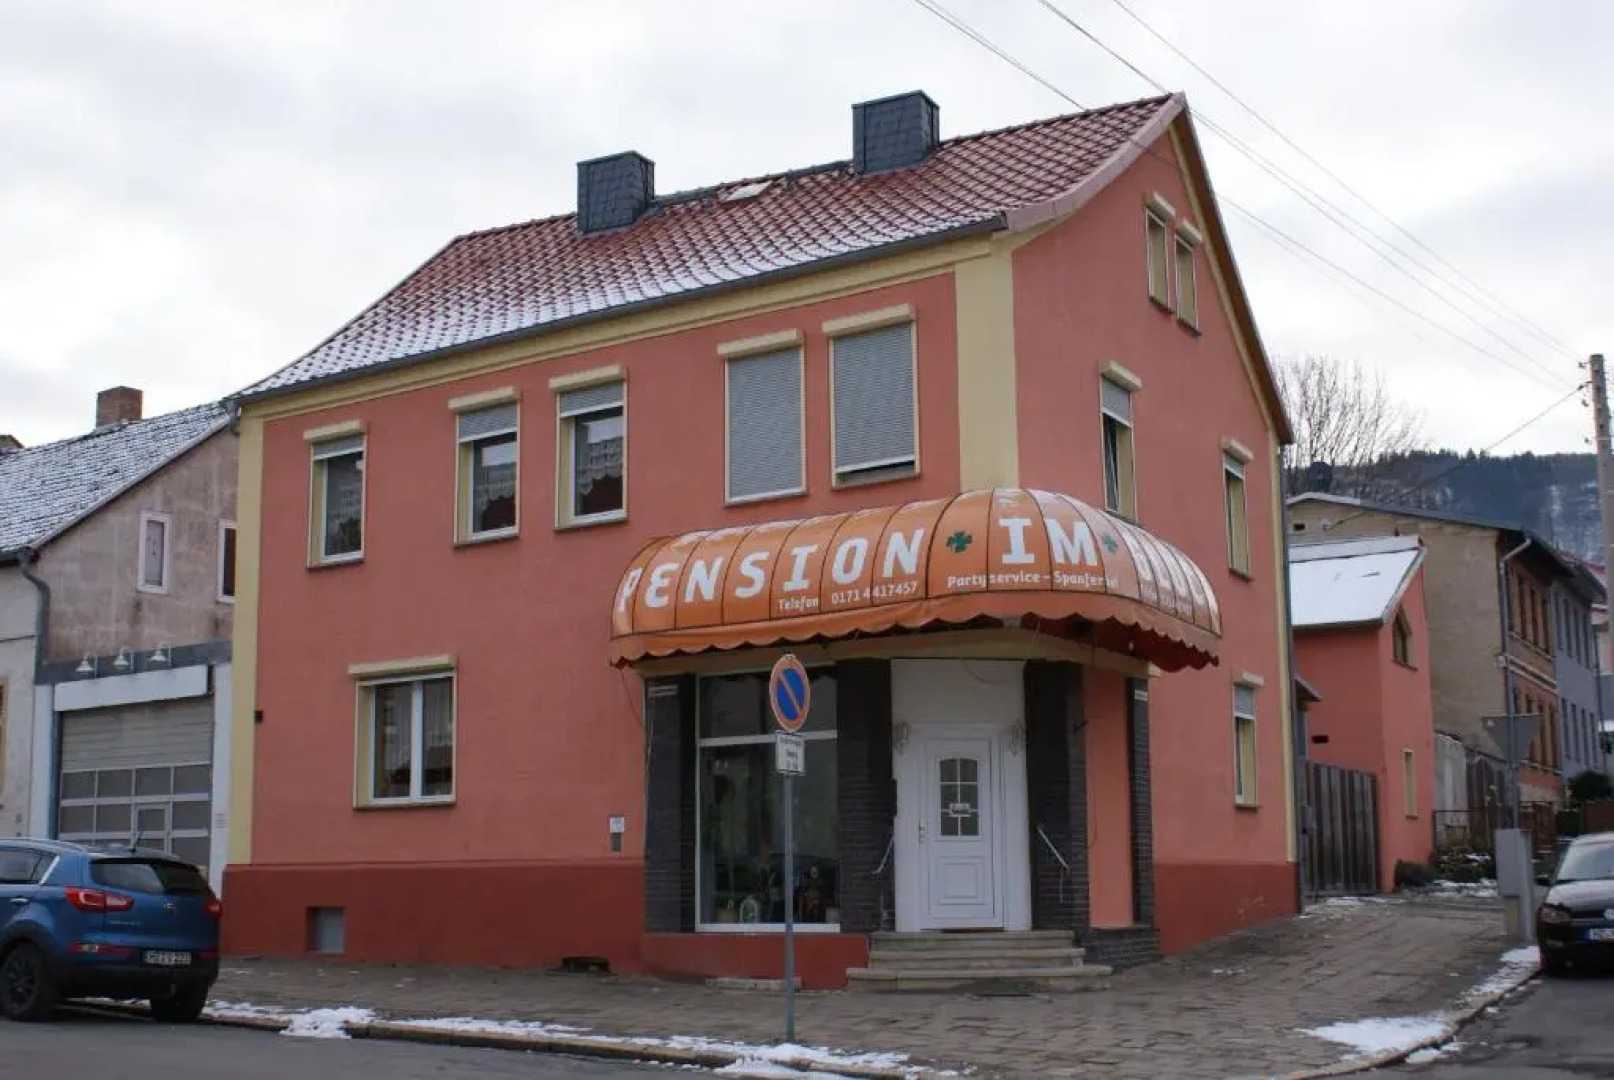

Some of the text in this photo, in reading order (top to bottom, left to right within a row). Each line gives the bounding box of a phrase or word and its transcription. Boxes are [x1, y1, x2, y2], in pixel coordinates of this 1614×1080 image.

[616, 528, 925, 613] PENSION
[999, 517, 1098, 567] IM
[779, 596, 819, 612] Telefon
[831, 588, 860, 605] 0171
